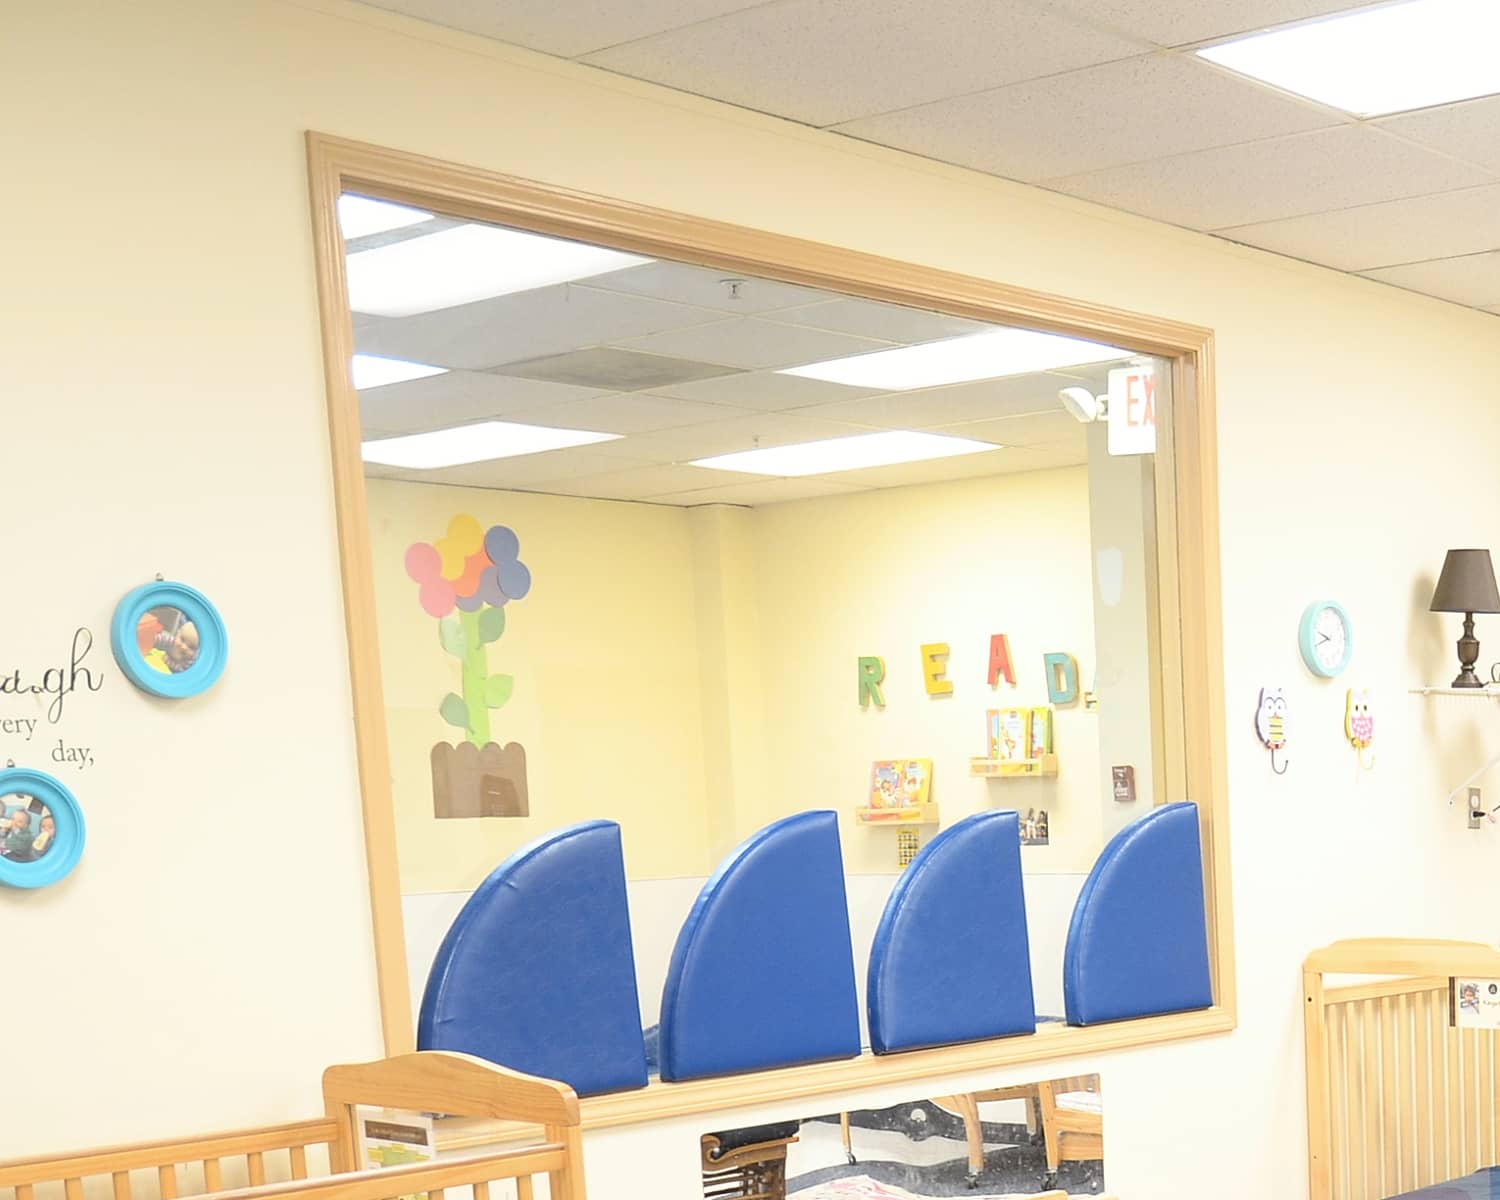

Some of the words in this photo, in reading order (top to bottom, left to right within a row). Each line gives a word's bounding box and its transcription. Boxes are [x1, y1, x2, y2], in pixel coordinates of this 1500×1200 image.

[1126, 374, 1156, 427] EX
[0, 627, 104, 725] agh
[858, 633, 1079, 707] READ
[0, 717, 38, 741] ery
[51, 739, 94, 770] day,
